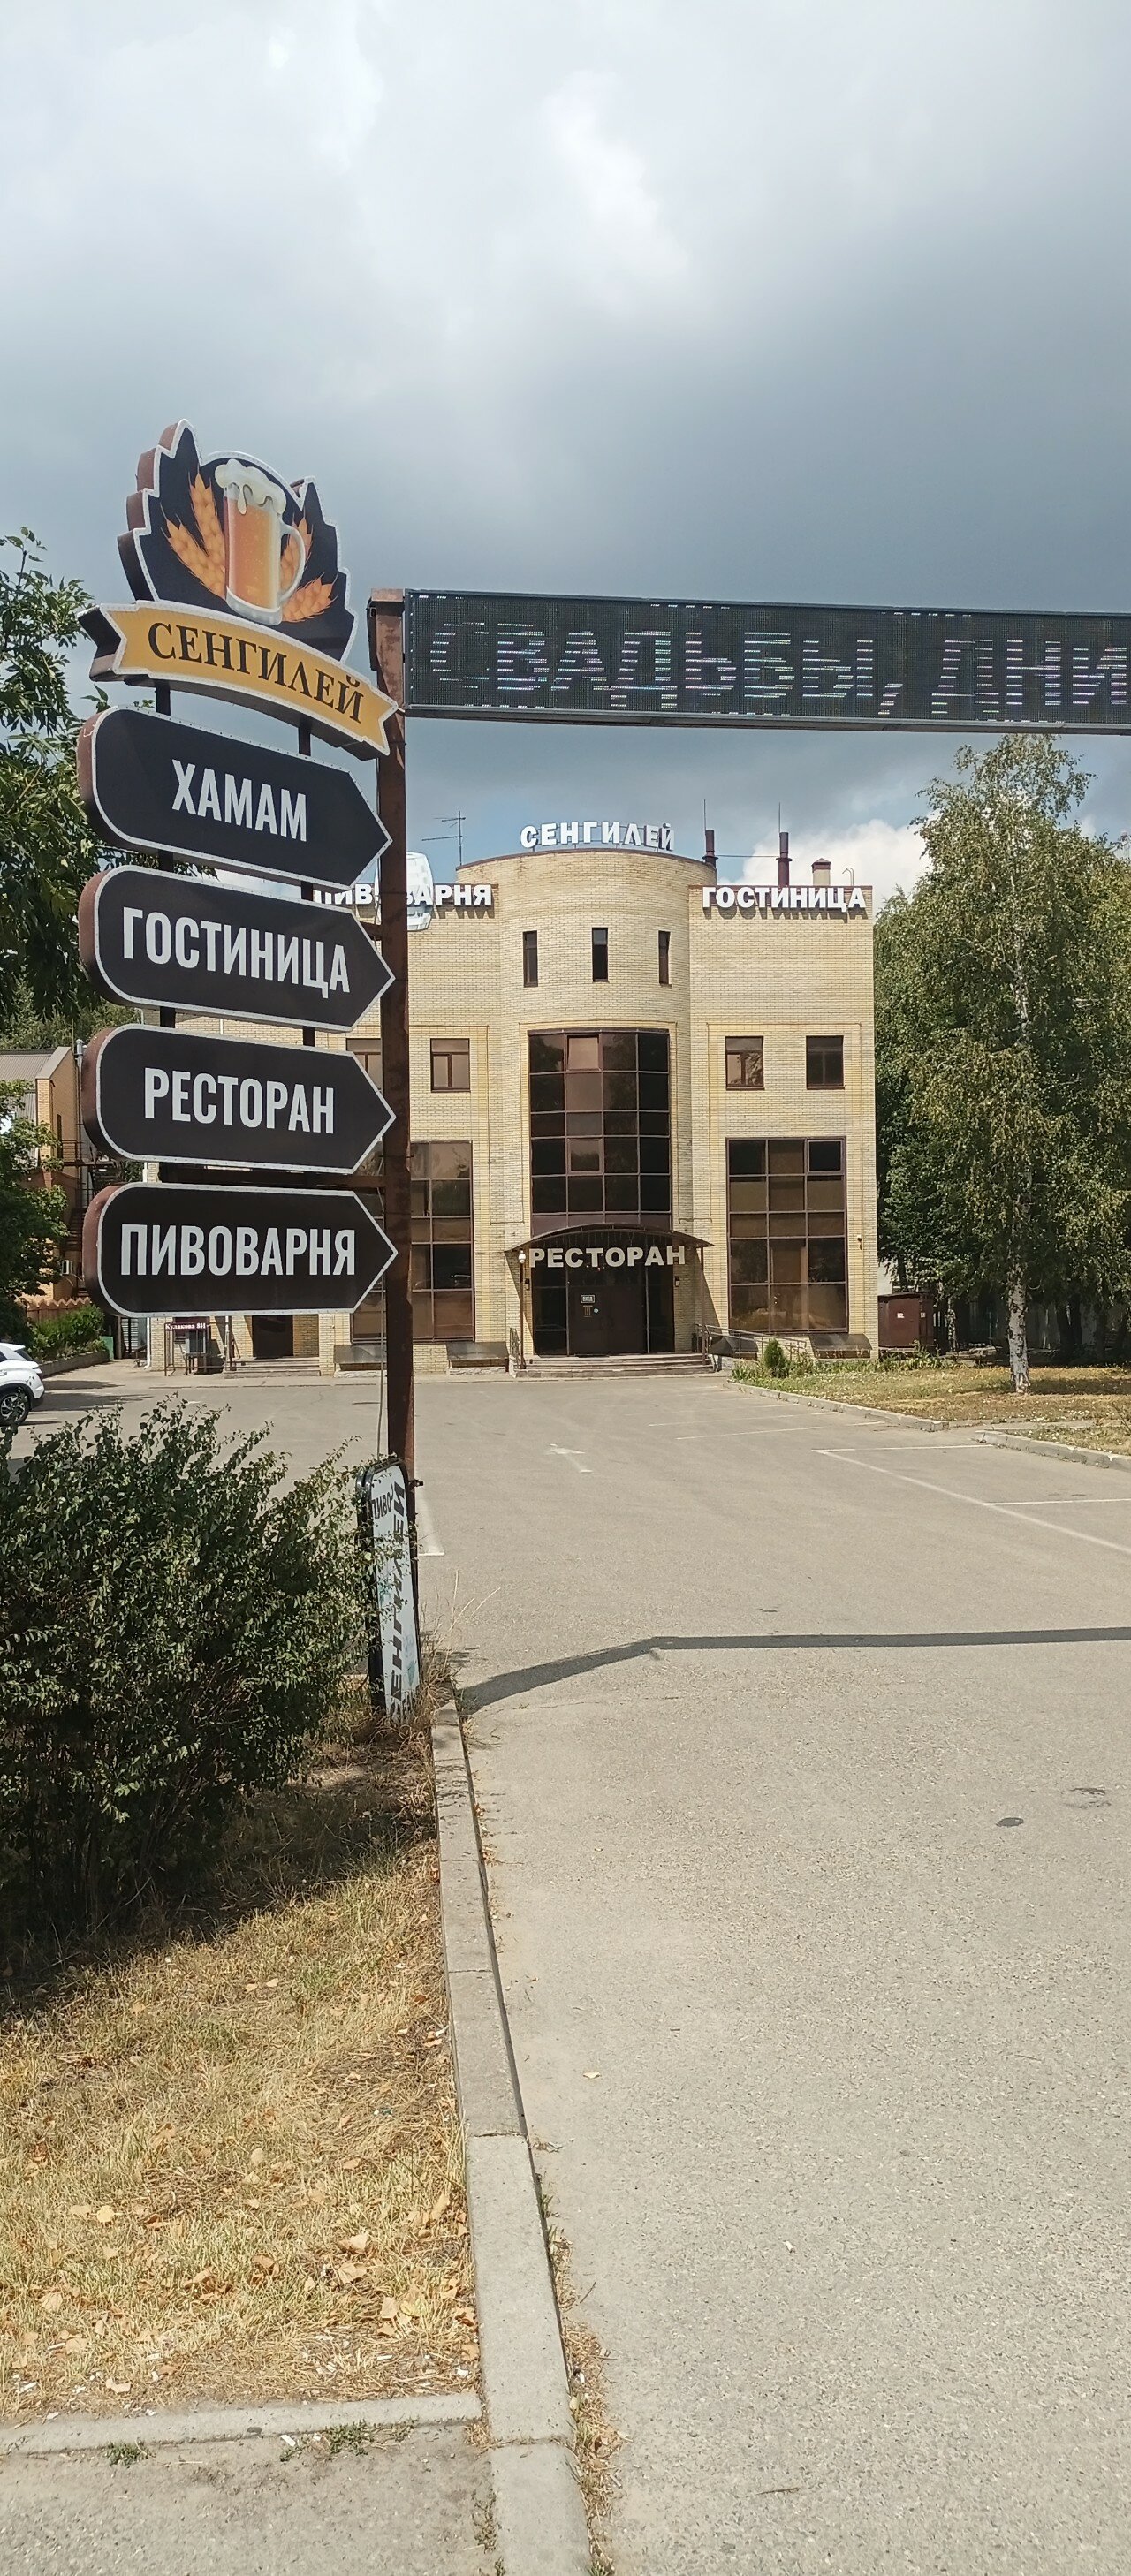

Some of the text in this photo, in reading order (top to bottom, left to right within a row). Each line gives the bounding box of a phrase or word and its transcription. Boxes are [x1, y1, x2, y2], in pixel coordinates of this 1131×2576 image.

[148, 622, 364, 724] СЕНГИЛЕЙ
[429, 622, 1127, 715] СВАДЬБЫ, ДНИ
[172, 760, 307, 842] ХАМАМ
[520, 821, 675, 851] СЕНГИЛЕЙ
[313, 884, 492, 905] ПИВАРНЯ
[702, 886, 867, 912] ГОСТИНИЦА
[122, 907, 351, 999] ГОСТИНИЦА
[144, 1067, 335, 1134] РЕСТОРАН
[121, 1224, 355, 1276] ПИВОВАРНЯ
[528, 1246, 685, 1268] РЕСТОРАН
